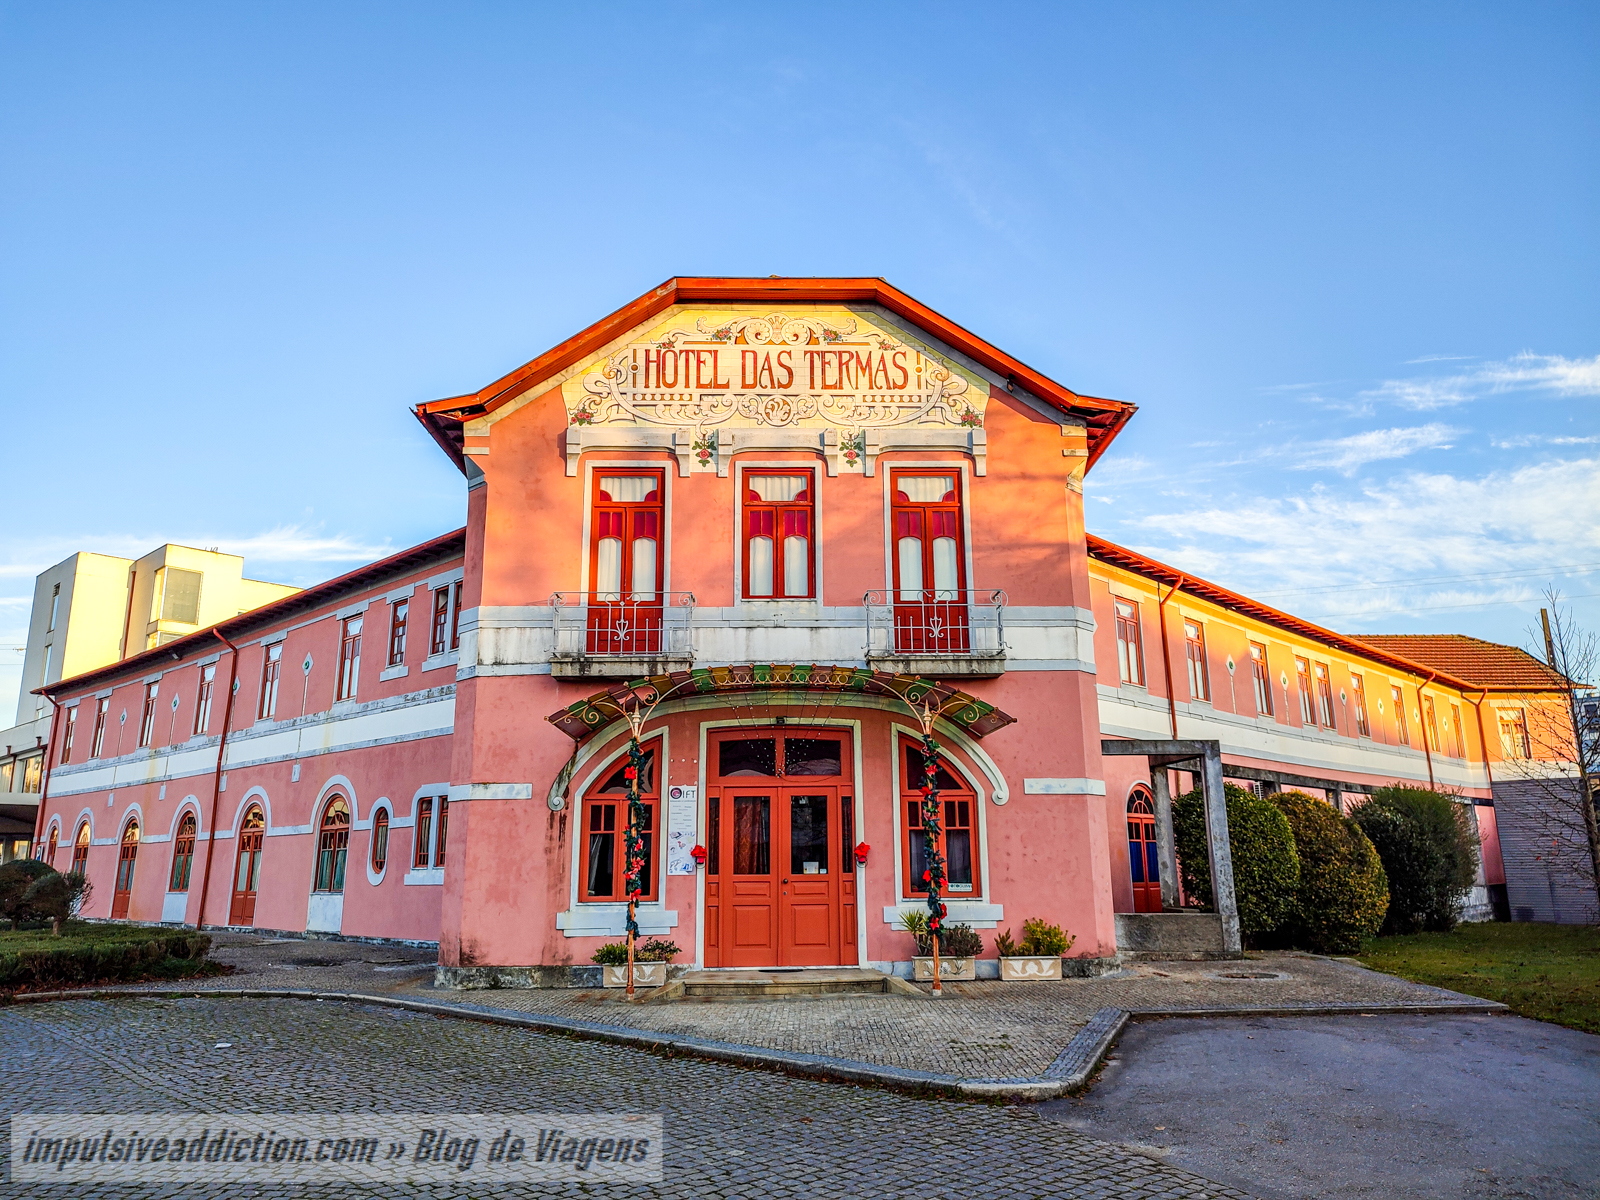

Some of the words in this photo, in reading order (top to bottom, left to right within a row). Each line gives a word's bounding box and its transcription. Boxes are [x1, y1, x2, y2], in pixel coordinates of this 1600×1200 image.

[643, 348, 730, 389] HOTEL
[740, 349, 794, 390] DAS
[804, 350, 909, 391] TERMAS
